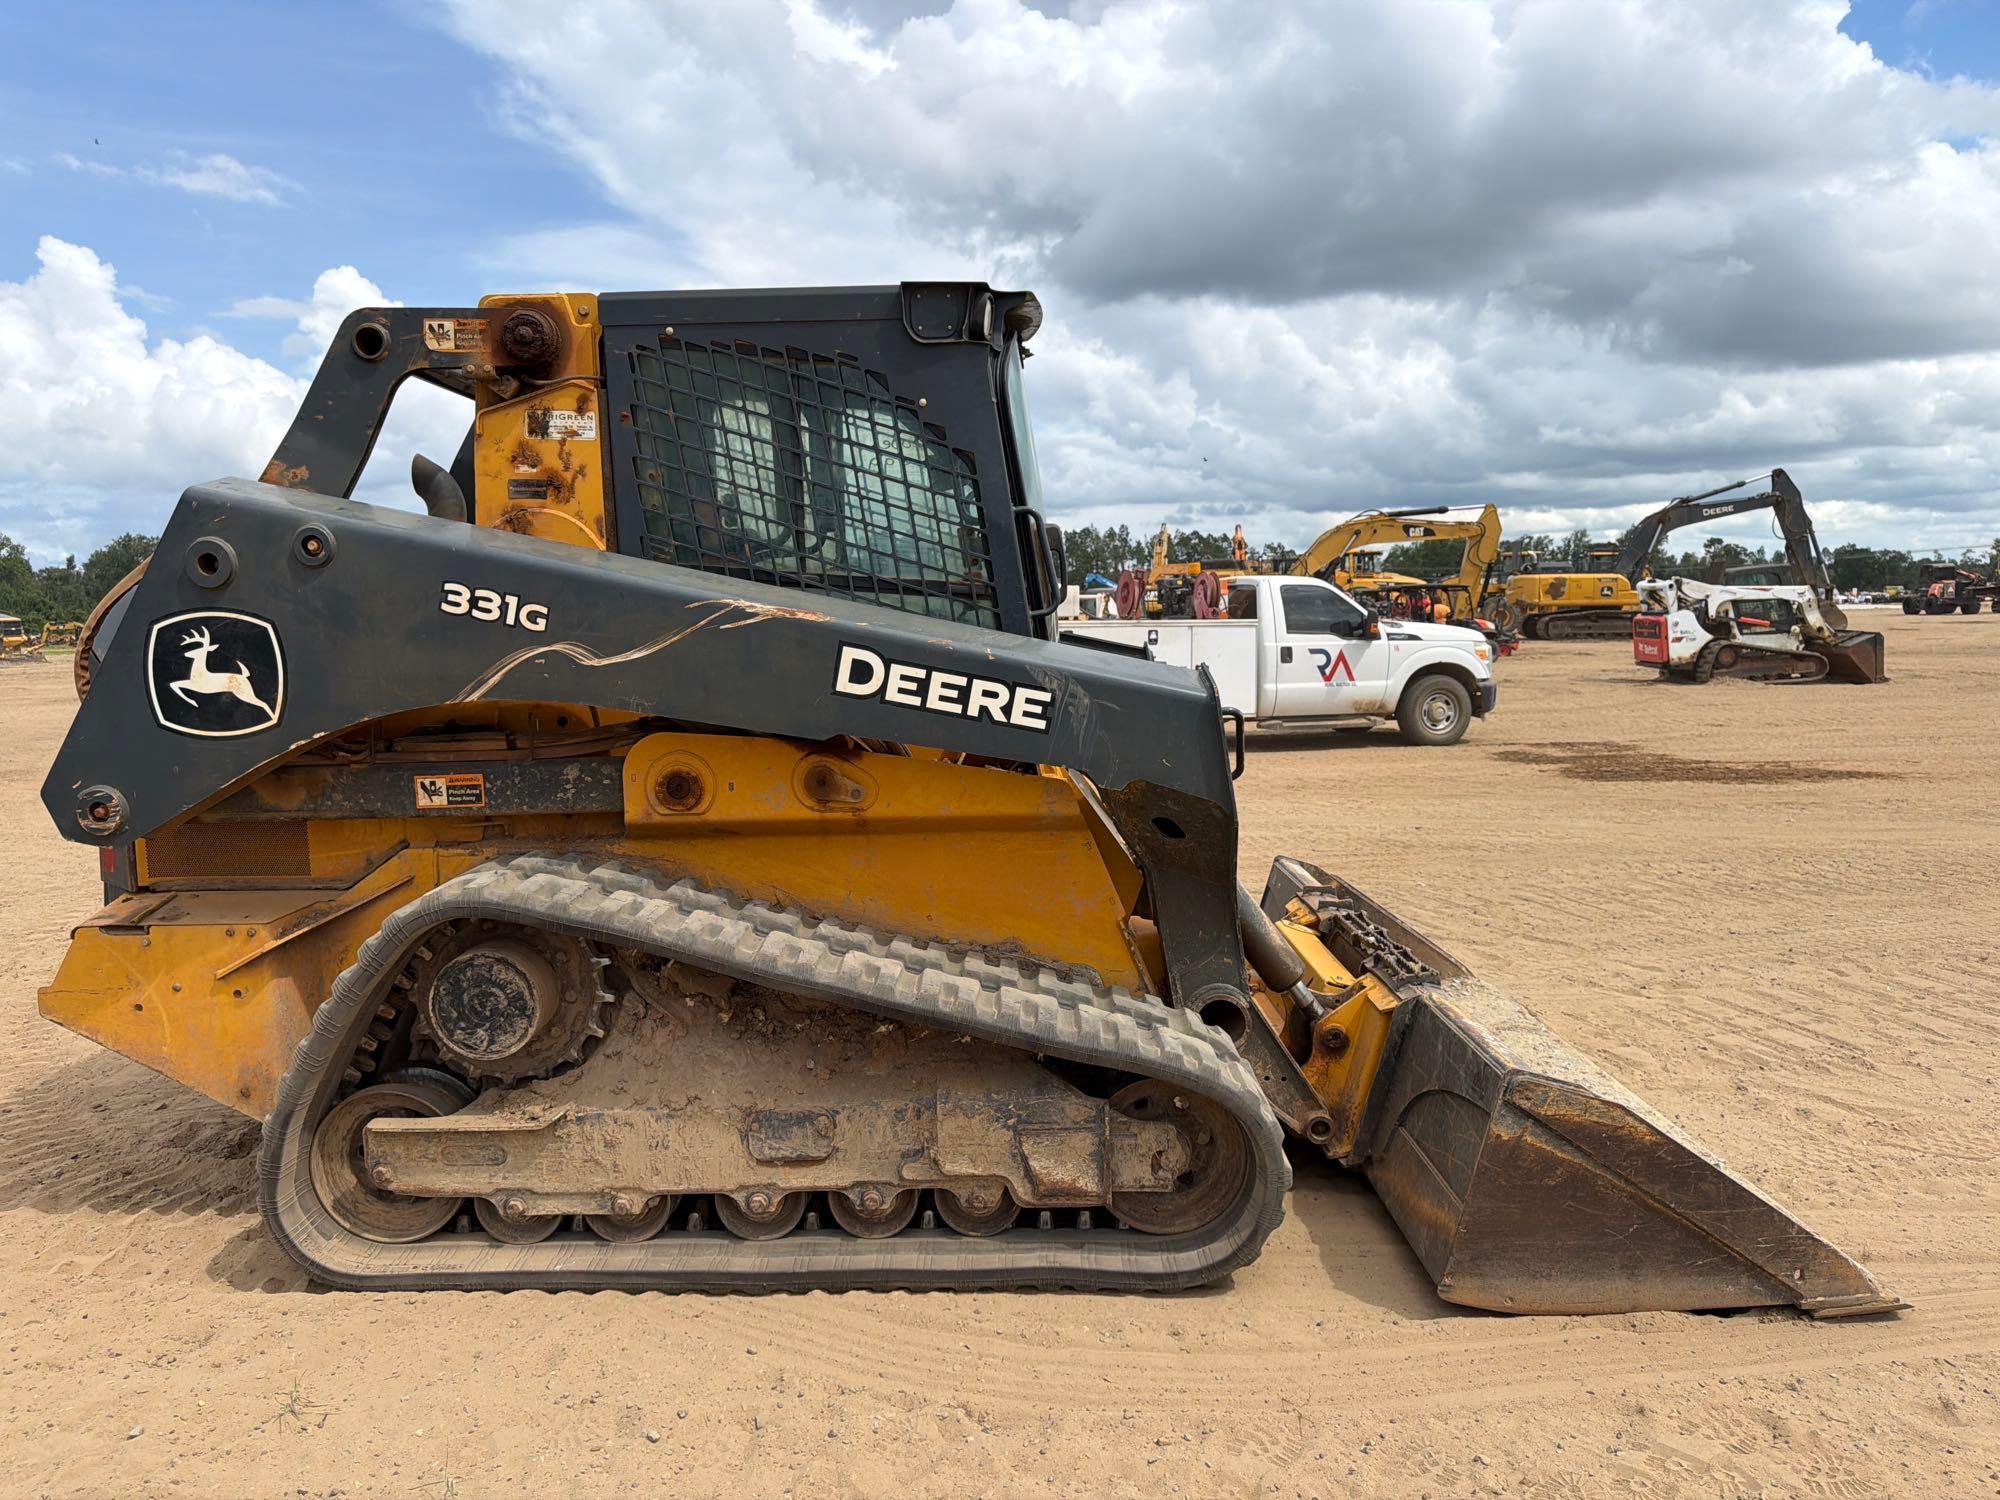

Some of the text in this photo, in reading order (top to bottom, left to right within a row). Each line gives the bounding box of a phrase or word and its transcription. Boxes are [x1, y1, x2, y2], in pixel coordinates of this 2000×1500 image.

[1702, 504, 1735, 516] DEERE
[1409, 526, 1425, 537] CAT
[440, 582, 548, 632] 331G
[1308, 648, 1355, 682] RA
[835, 645, 1052, 730] DEERE
